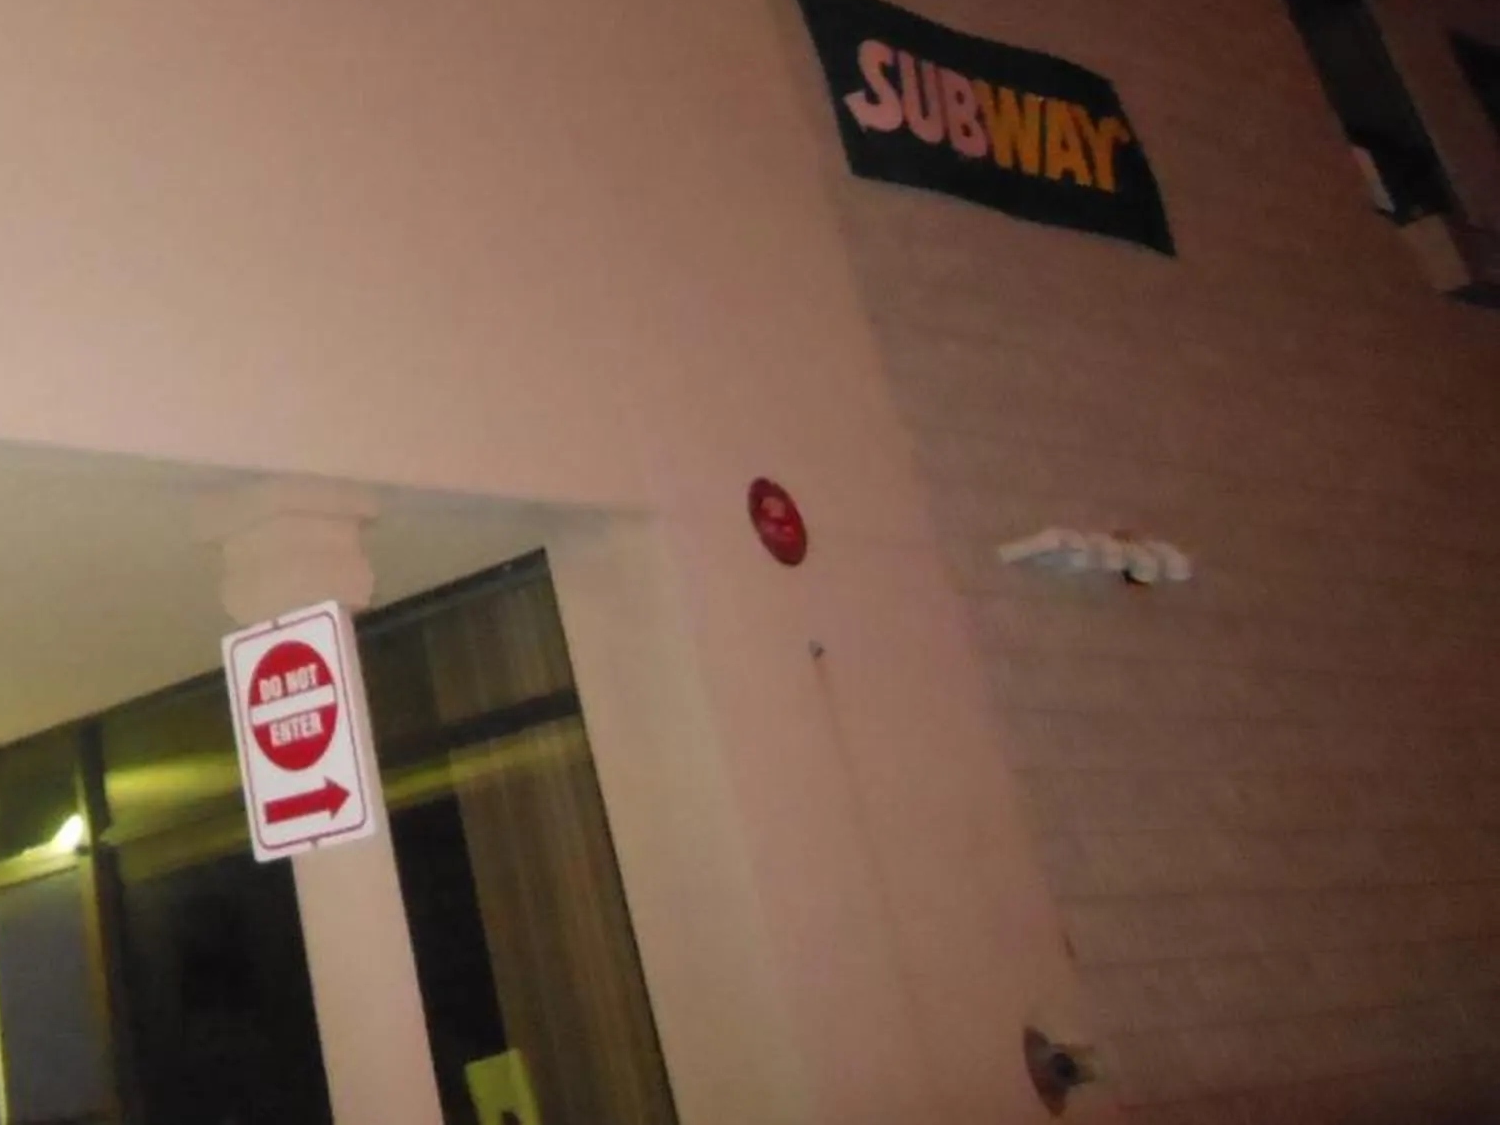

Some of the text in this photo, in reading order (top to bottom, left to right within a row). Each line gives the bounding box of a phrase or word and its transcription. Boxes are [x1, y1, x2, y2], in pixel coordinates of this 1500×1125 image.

[843, 38, 1130, 194] SUBWAY
[258, 662, 318, 702] DO NOT
[268, 711, 324, 748] ENTER
